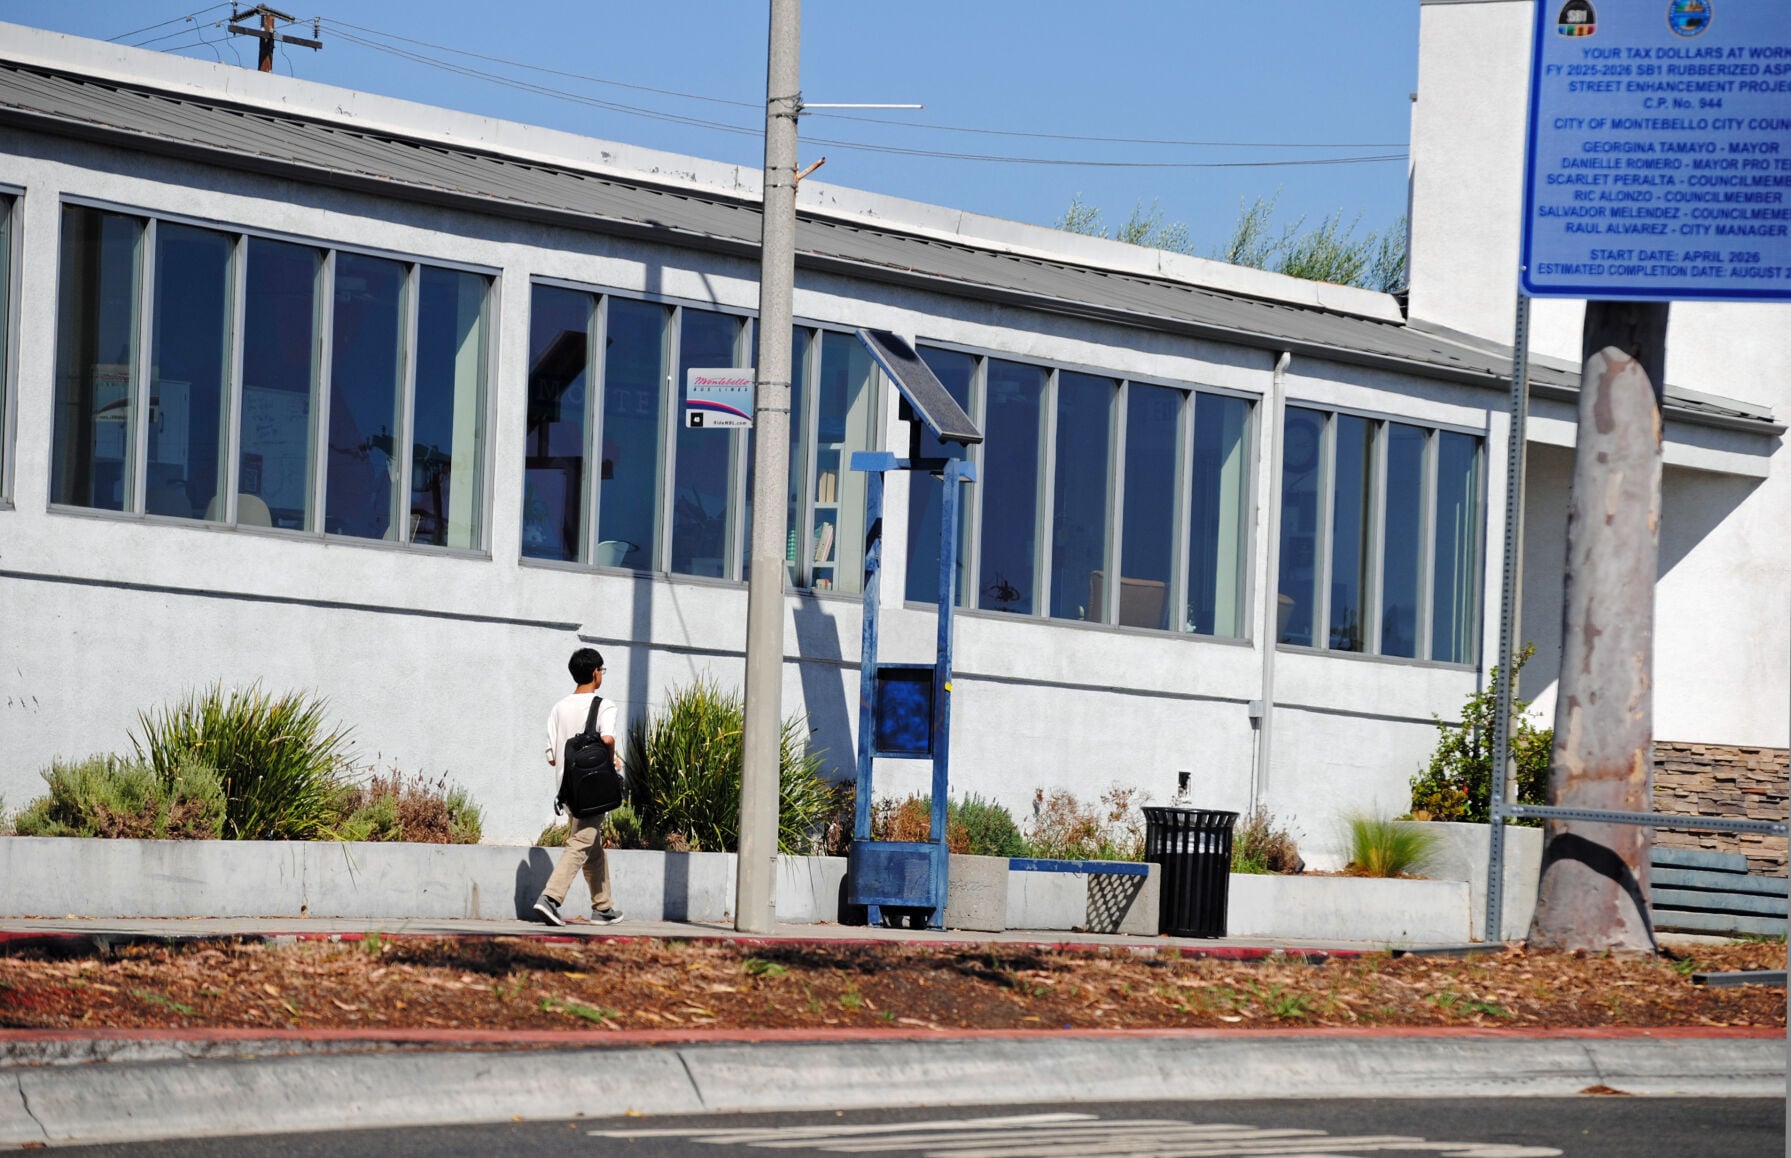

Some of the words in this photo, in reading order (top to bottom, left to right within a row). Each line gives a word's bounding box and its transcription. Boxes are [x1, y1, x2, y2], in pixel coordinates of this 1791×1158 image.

[1582, 48, 1622, 59] YOUR
[1626, 48, 1651, 59] TAX
[1655, 47, 1723, 59] DOLLARS
[1726, 47, 1745, 59] AT
[1546, 64, 1563, 76] FY
[1567, 64, 1632, 76] 2025-2026
[1636, 64, 1662, 76] SB1
[1666, 64, 1760, 76] RUBBERIZED
[1568, 80, 1623, 92] STREET
[1625, 81, 1735, 93] ENHANCEMENT
[1643, 97, 1668, 109] C.P.
[1672, 98, 1694, 109] No.
[1699, 97, 1722, 109] 944
[1554, 118, 1585, 130] CITY
[1588, 118, 1607, 130] OF
[1610, 118, 1708, 130] MONTEBELLO
[1711, 118, 1745, 130] CITY
[1582, 141, 1656, 153] GEORGINA
[1659, 142, 1717, 154] TAMAYO
[1728, 142, 1780, 154] MAYOR
[1561, 157, 1622, 170] DANIELLE
[1625, 158, 1682, 170] ROMERO
[1692, 158, 1739, 170] MAYOR
[1742, 158, 1770, 171] PRO
[1547, 173, 1610, 186] SCARLET
[1613, 174, 1676, 186] PERALTA
[1573, 190, 1596, 202] RIC
[1599, 190, 1653, 202] ALONZO
[1663, 191, 1783, 204] COUNCILMEMBER
[1538, 205, 1606, 218] SALVADOR
[1609, 207, 1680, 219] MELENDEZ
[1565, 222, 1603, 234] RAUL
[1605, 223, 1668, 235] ALVAREZ
[1679, 224, 1712, 236] CITY
[1715, 224, 1788, 236] MANAGER
[1590, 249, 1634, 261] START
[1637, 250, 1678, 262] DATE:
[1682, 251, 1724, 263] APRIL
[1728, 251, 1760, 264] 2026
[1537, 263, 1605, 276] ESTIMATED
[1607, 264, 1688, 277] COMPLETION
[1690, 265, 1727, 278] DATE:
[1729, 266, 1782, 279] AUGUST
[694, 376, 751, 386] Montebello
